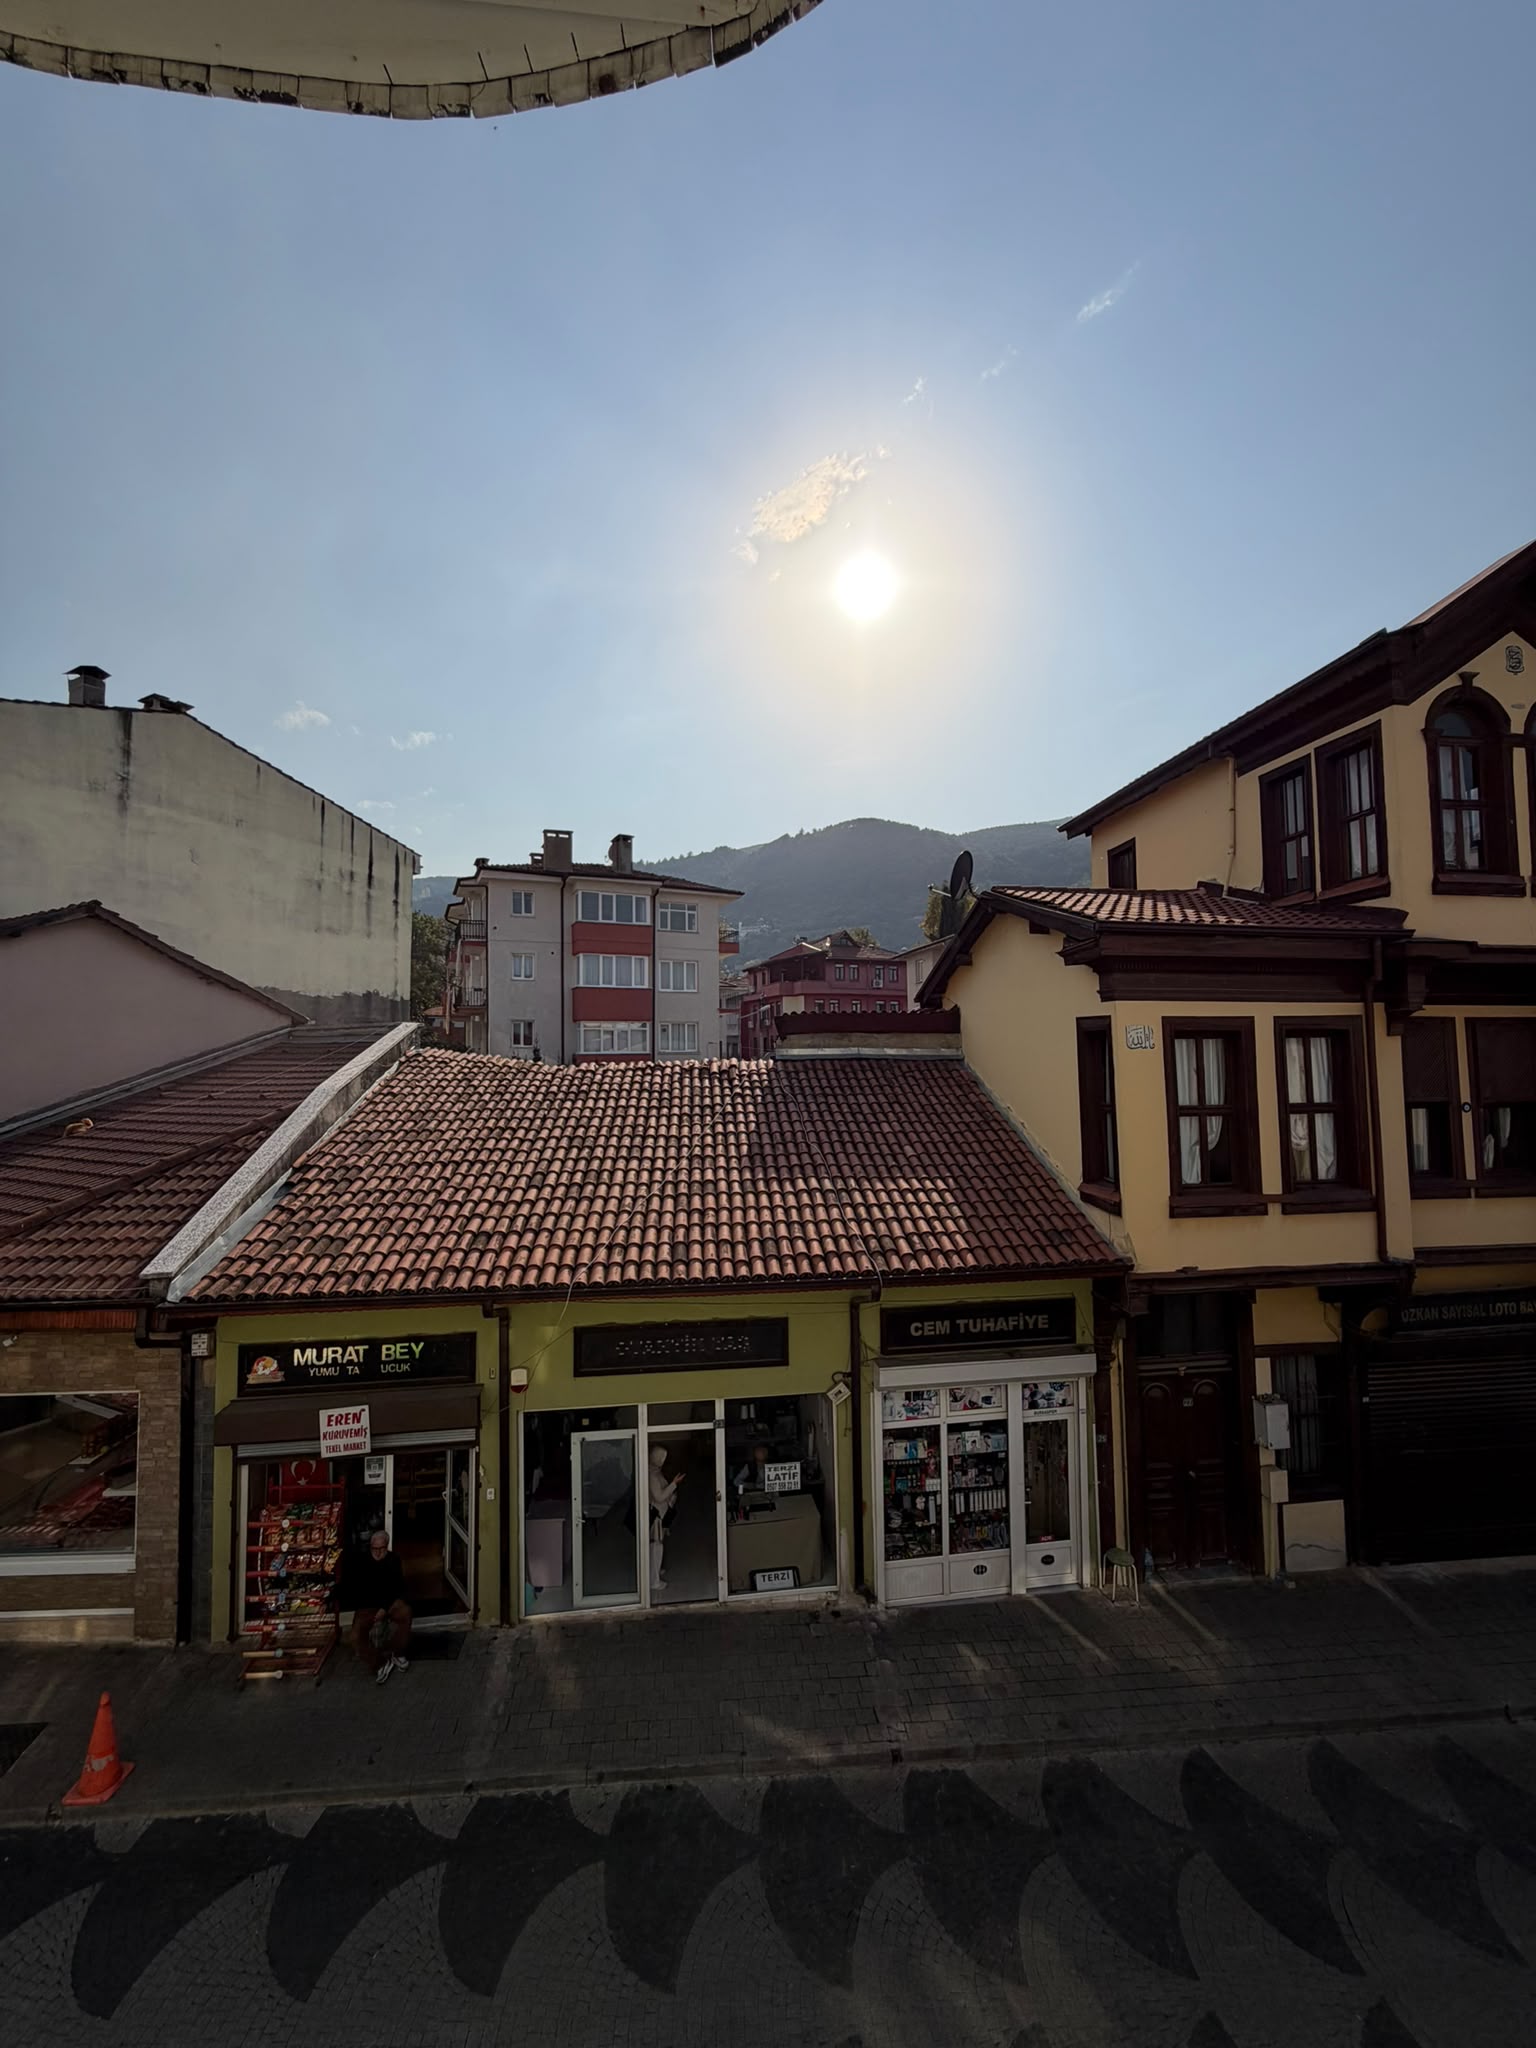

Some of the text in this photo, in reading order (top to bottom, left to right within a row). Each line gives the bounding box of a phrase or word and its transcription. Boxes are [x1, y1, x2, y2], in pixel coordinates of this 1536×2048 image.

[1489, 1301, 1517, 1317] LOTO
[910, 1312, 1049, 1337] CEM TUHAFİYE
[293, 1341, 425, 1367] MURAT BEY
[326, 1408, 366, 1428] EREN
[325, 1444, 342, 1454] TEKEL
[767, 1463, 797, 1472] TERZİ
[767, 1470, 799, 1482] LATİF
[761, 1570, 790, 1583] TERZİ
